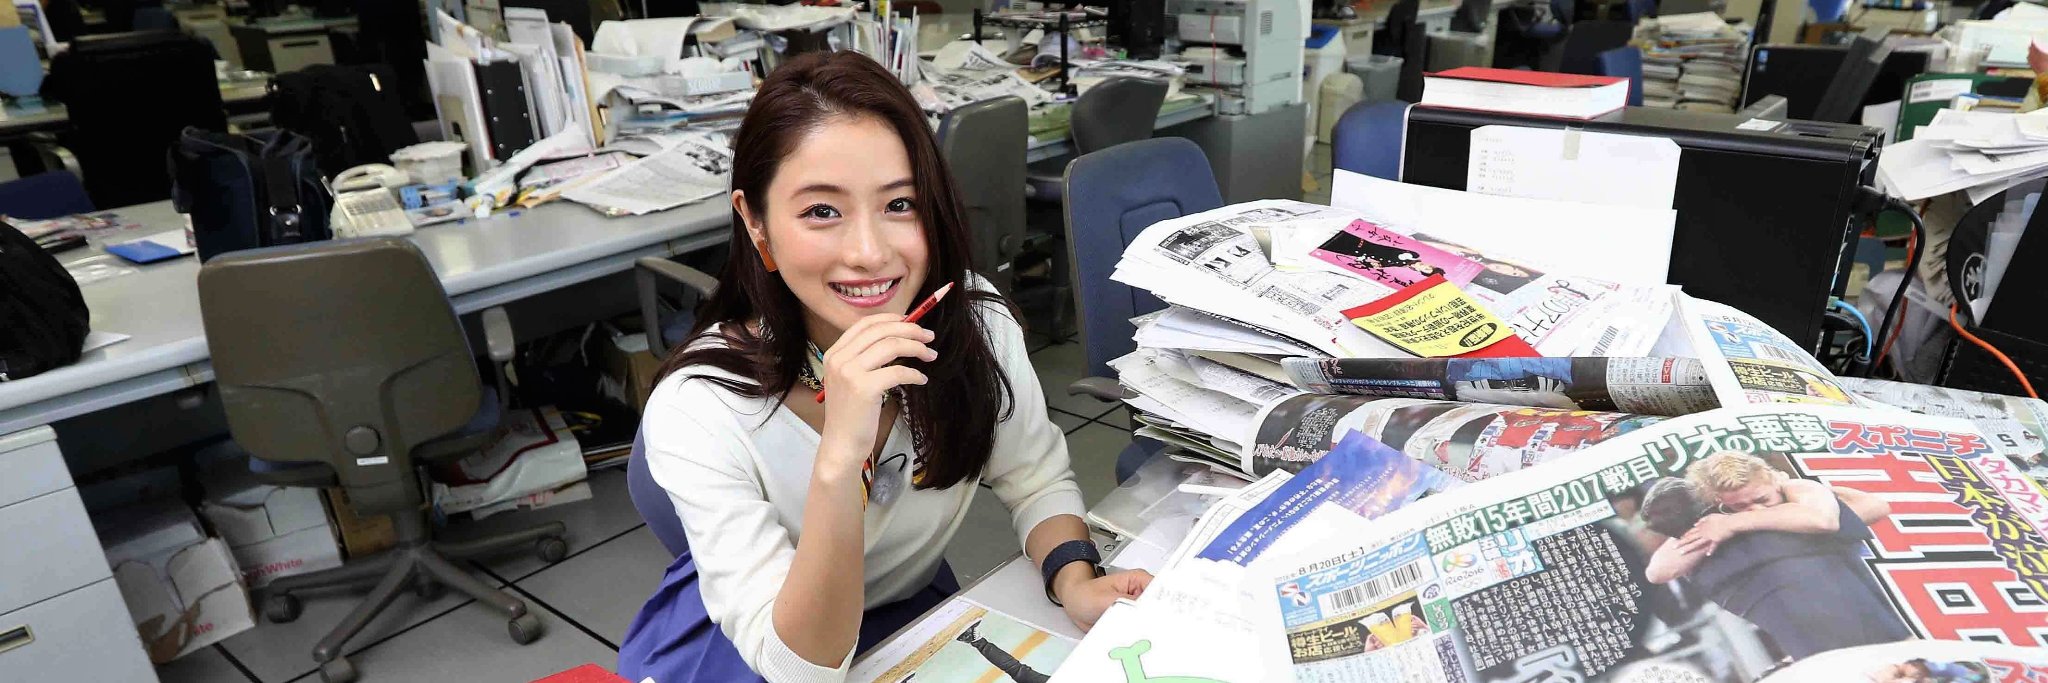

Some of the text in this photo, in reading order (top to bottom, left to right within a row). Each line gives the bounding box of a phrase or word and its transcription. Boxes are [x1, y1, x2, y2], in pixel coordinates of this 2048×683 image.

[1828, 420, 1991, 459] スポニチ
[1979, 457, 2048, 533] タカマ
[1305, 531, 1422, 590] スポーツニッポン
